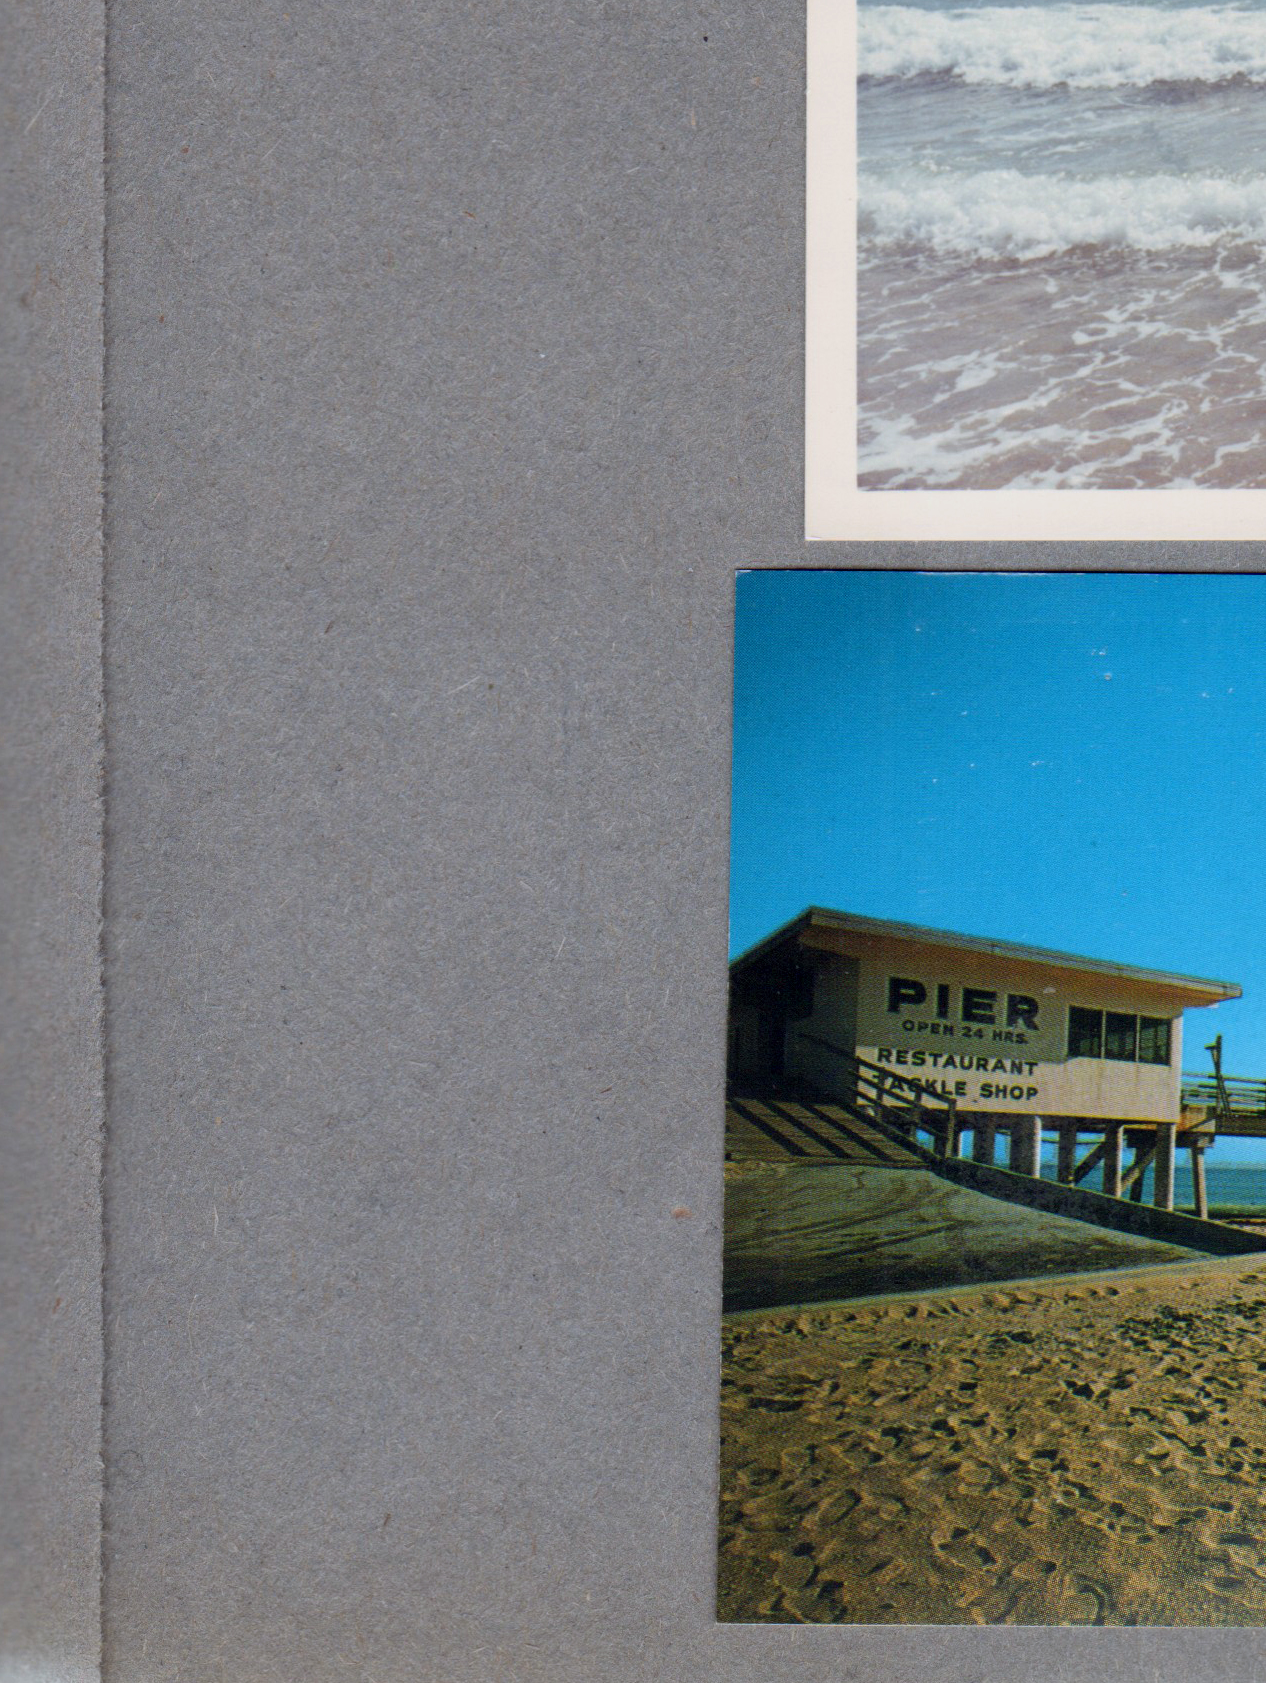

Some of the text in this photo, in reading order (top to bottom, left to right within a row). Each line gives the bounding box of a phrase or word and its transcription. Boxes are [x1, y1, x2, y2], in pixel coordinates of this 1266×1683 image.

[886, 976, 1040, 1031] PIER
[902, 1019, 954, 1036] OPEN
[961, 1026, 984, 1040] 24
[877, 1047, 1038, 1077] RESTAURANT
[979, 1082, 1039, 1101] SHOP
